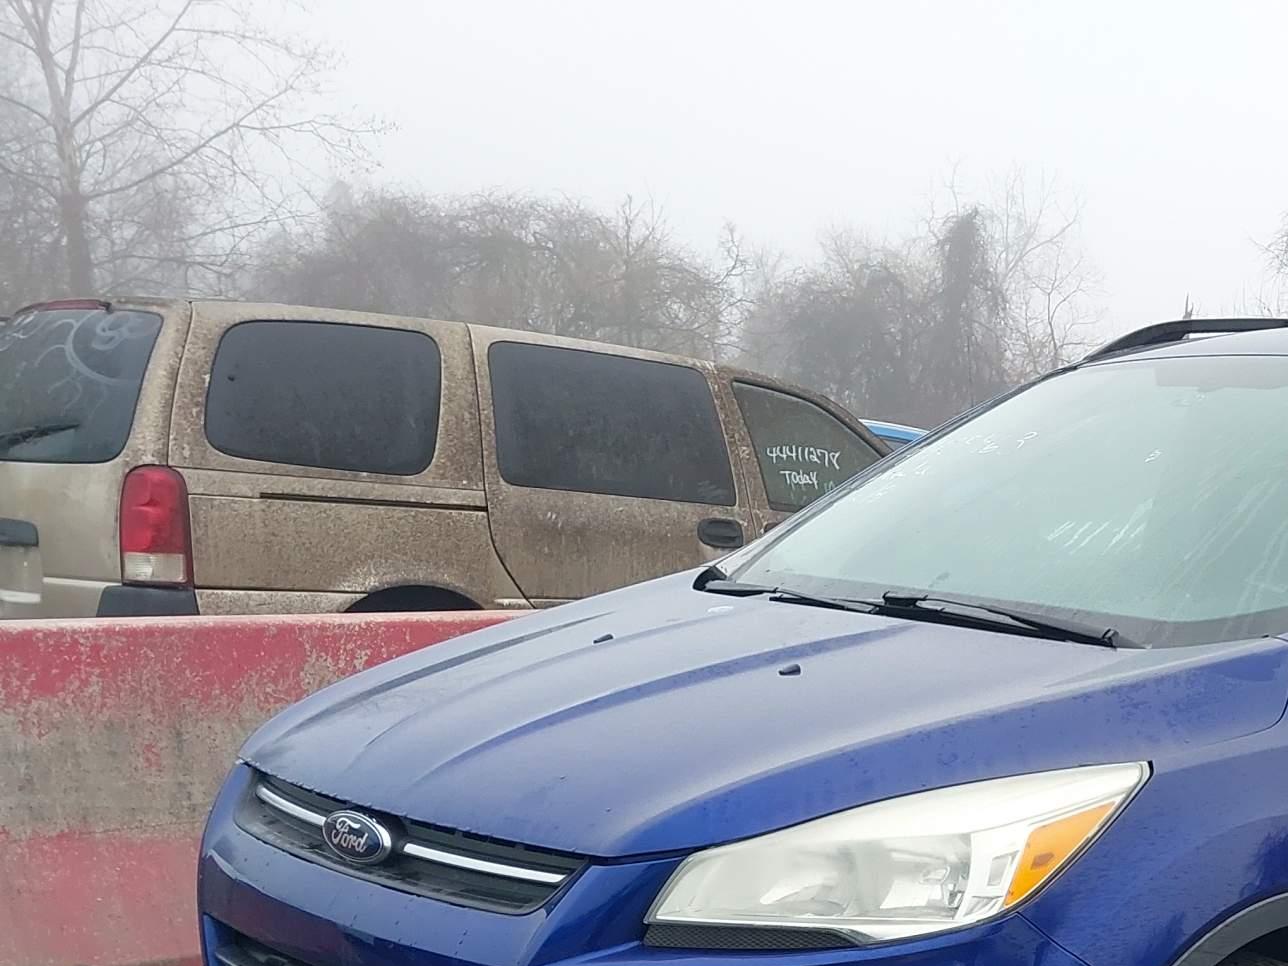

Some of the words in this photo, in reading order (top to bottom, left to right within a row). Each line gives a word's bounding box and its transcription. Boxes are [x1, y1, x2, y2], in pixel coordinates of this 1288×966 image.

[766, 445, 841, 470] 44411278
[779, 470, 819, 489] Today
[331, 817, 369, 853] Ford
